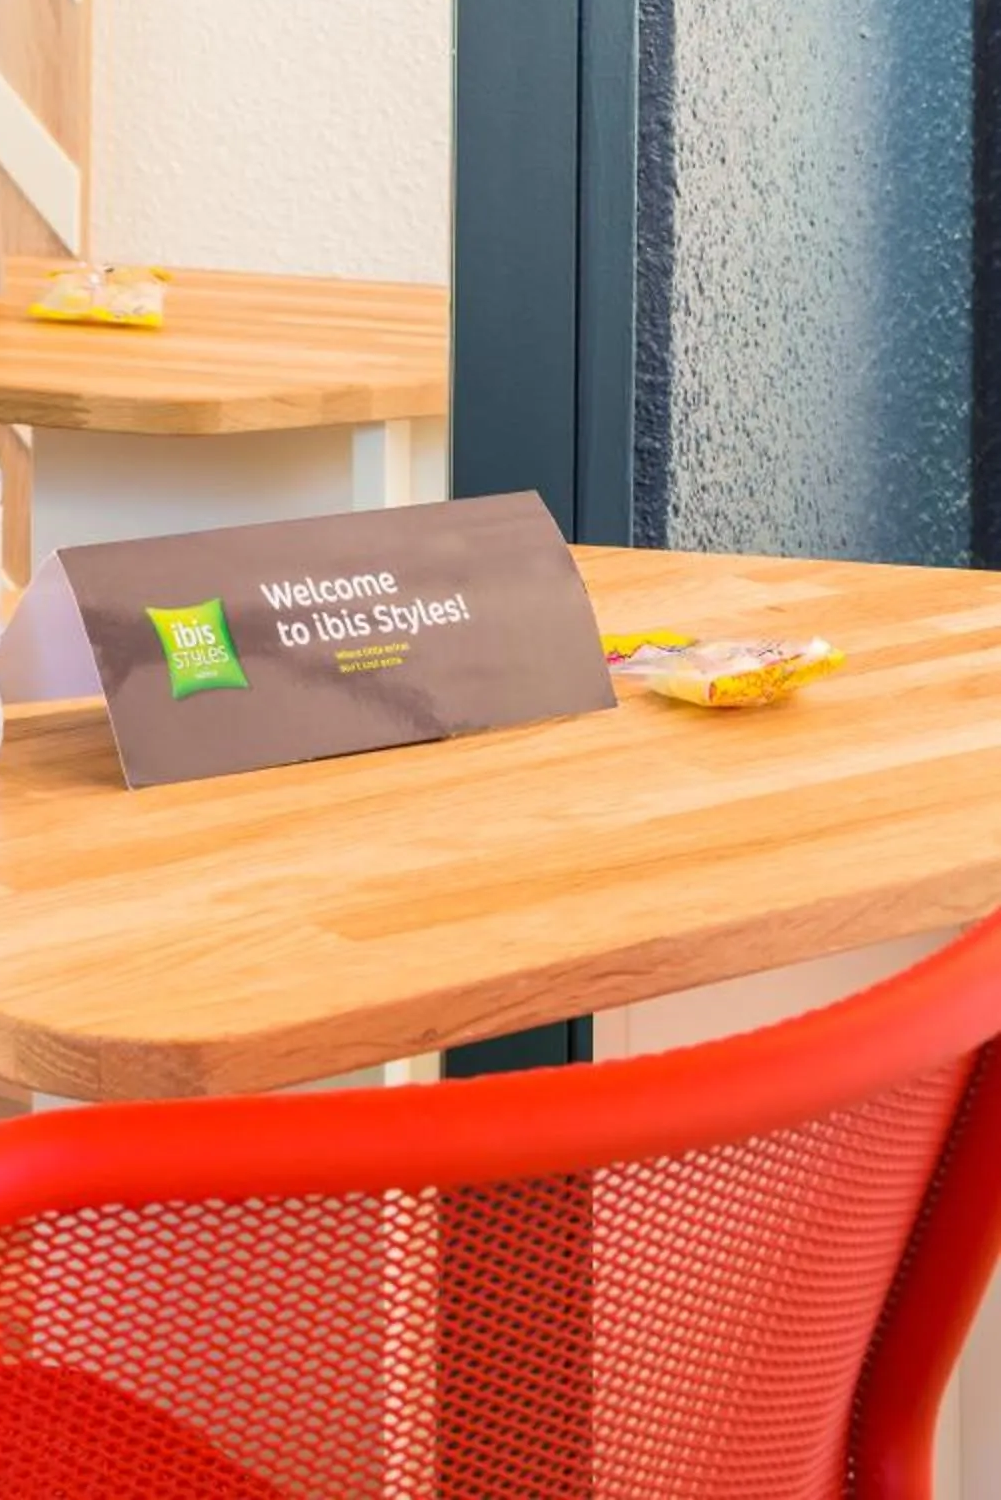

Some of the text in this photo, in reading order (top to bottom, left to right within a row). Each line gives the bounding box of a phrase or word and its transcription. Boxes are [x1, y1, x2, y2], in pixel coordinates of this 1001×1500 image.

[260, 571, 398, 610] Welcome
[170, 620, 216, 649] ibis
[276, 593, 471, 646] to ibis Styles!
